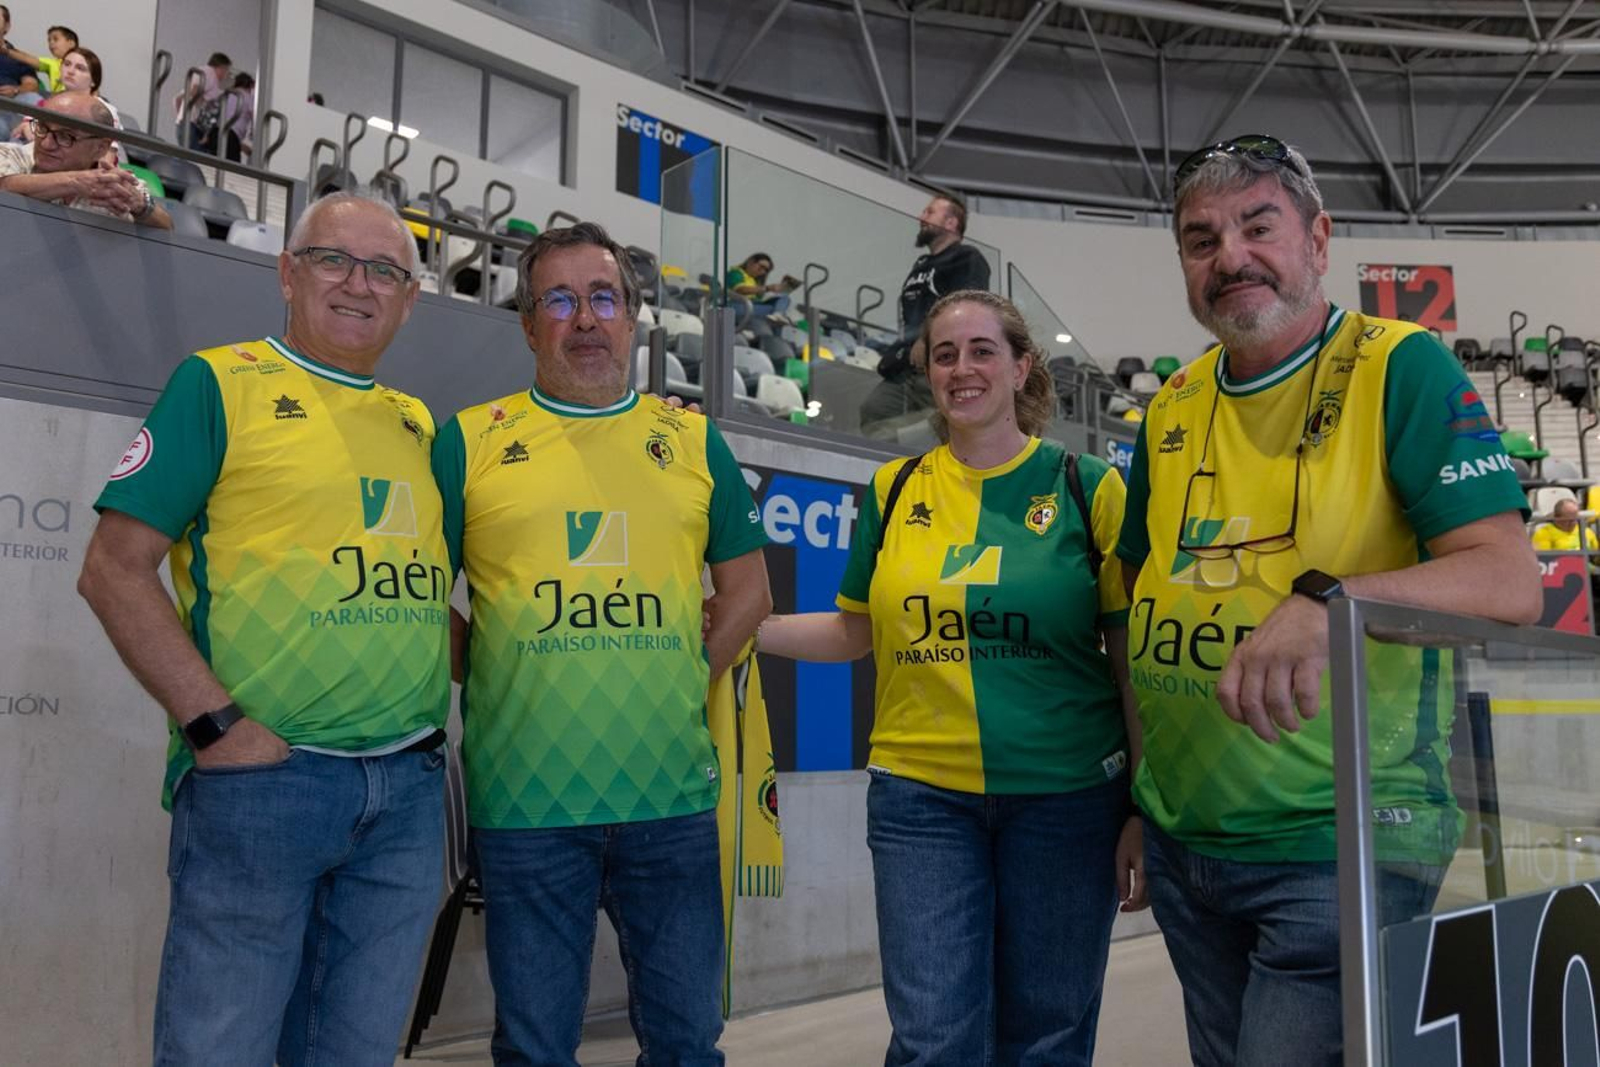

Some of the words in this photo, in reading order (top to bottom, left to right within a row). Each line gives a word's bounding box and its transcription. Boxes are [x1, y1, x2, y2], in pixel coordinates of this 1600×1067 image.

[617, 105, 686, 149] Sector
[1358, 264, 1418, 282] Sector
[332, 545, 447, 603] Jaén
[310, 601, 400, 628] PARAÍSO
[534, 577, 662, 635] Jaén
[903, 594, 1030, 646] Jaén
[516, 631, 597, 656] PARAÍSO
[601, 634, 683, 652] INTERIOR
[896, 643, 965, 666] PARAÍSO
[969, 644, 1055, 662] INTERIOR
[1415, 883, 1600, 1067] 10
